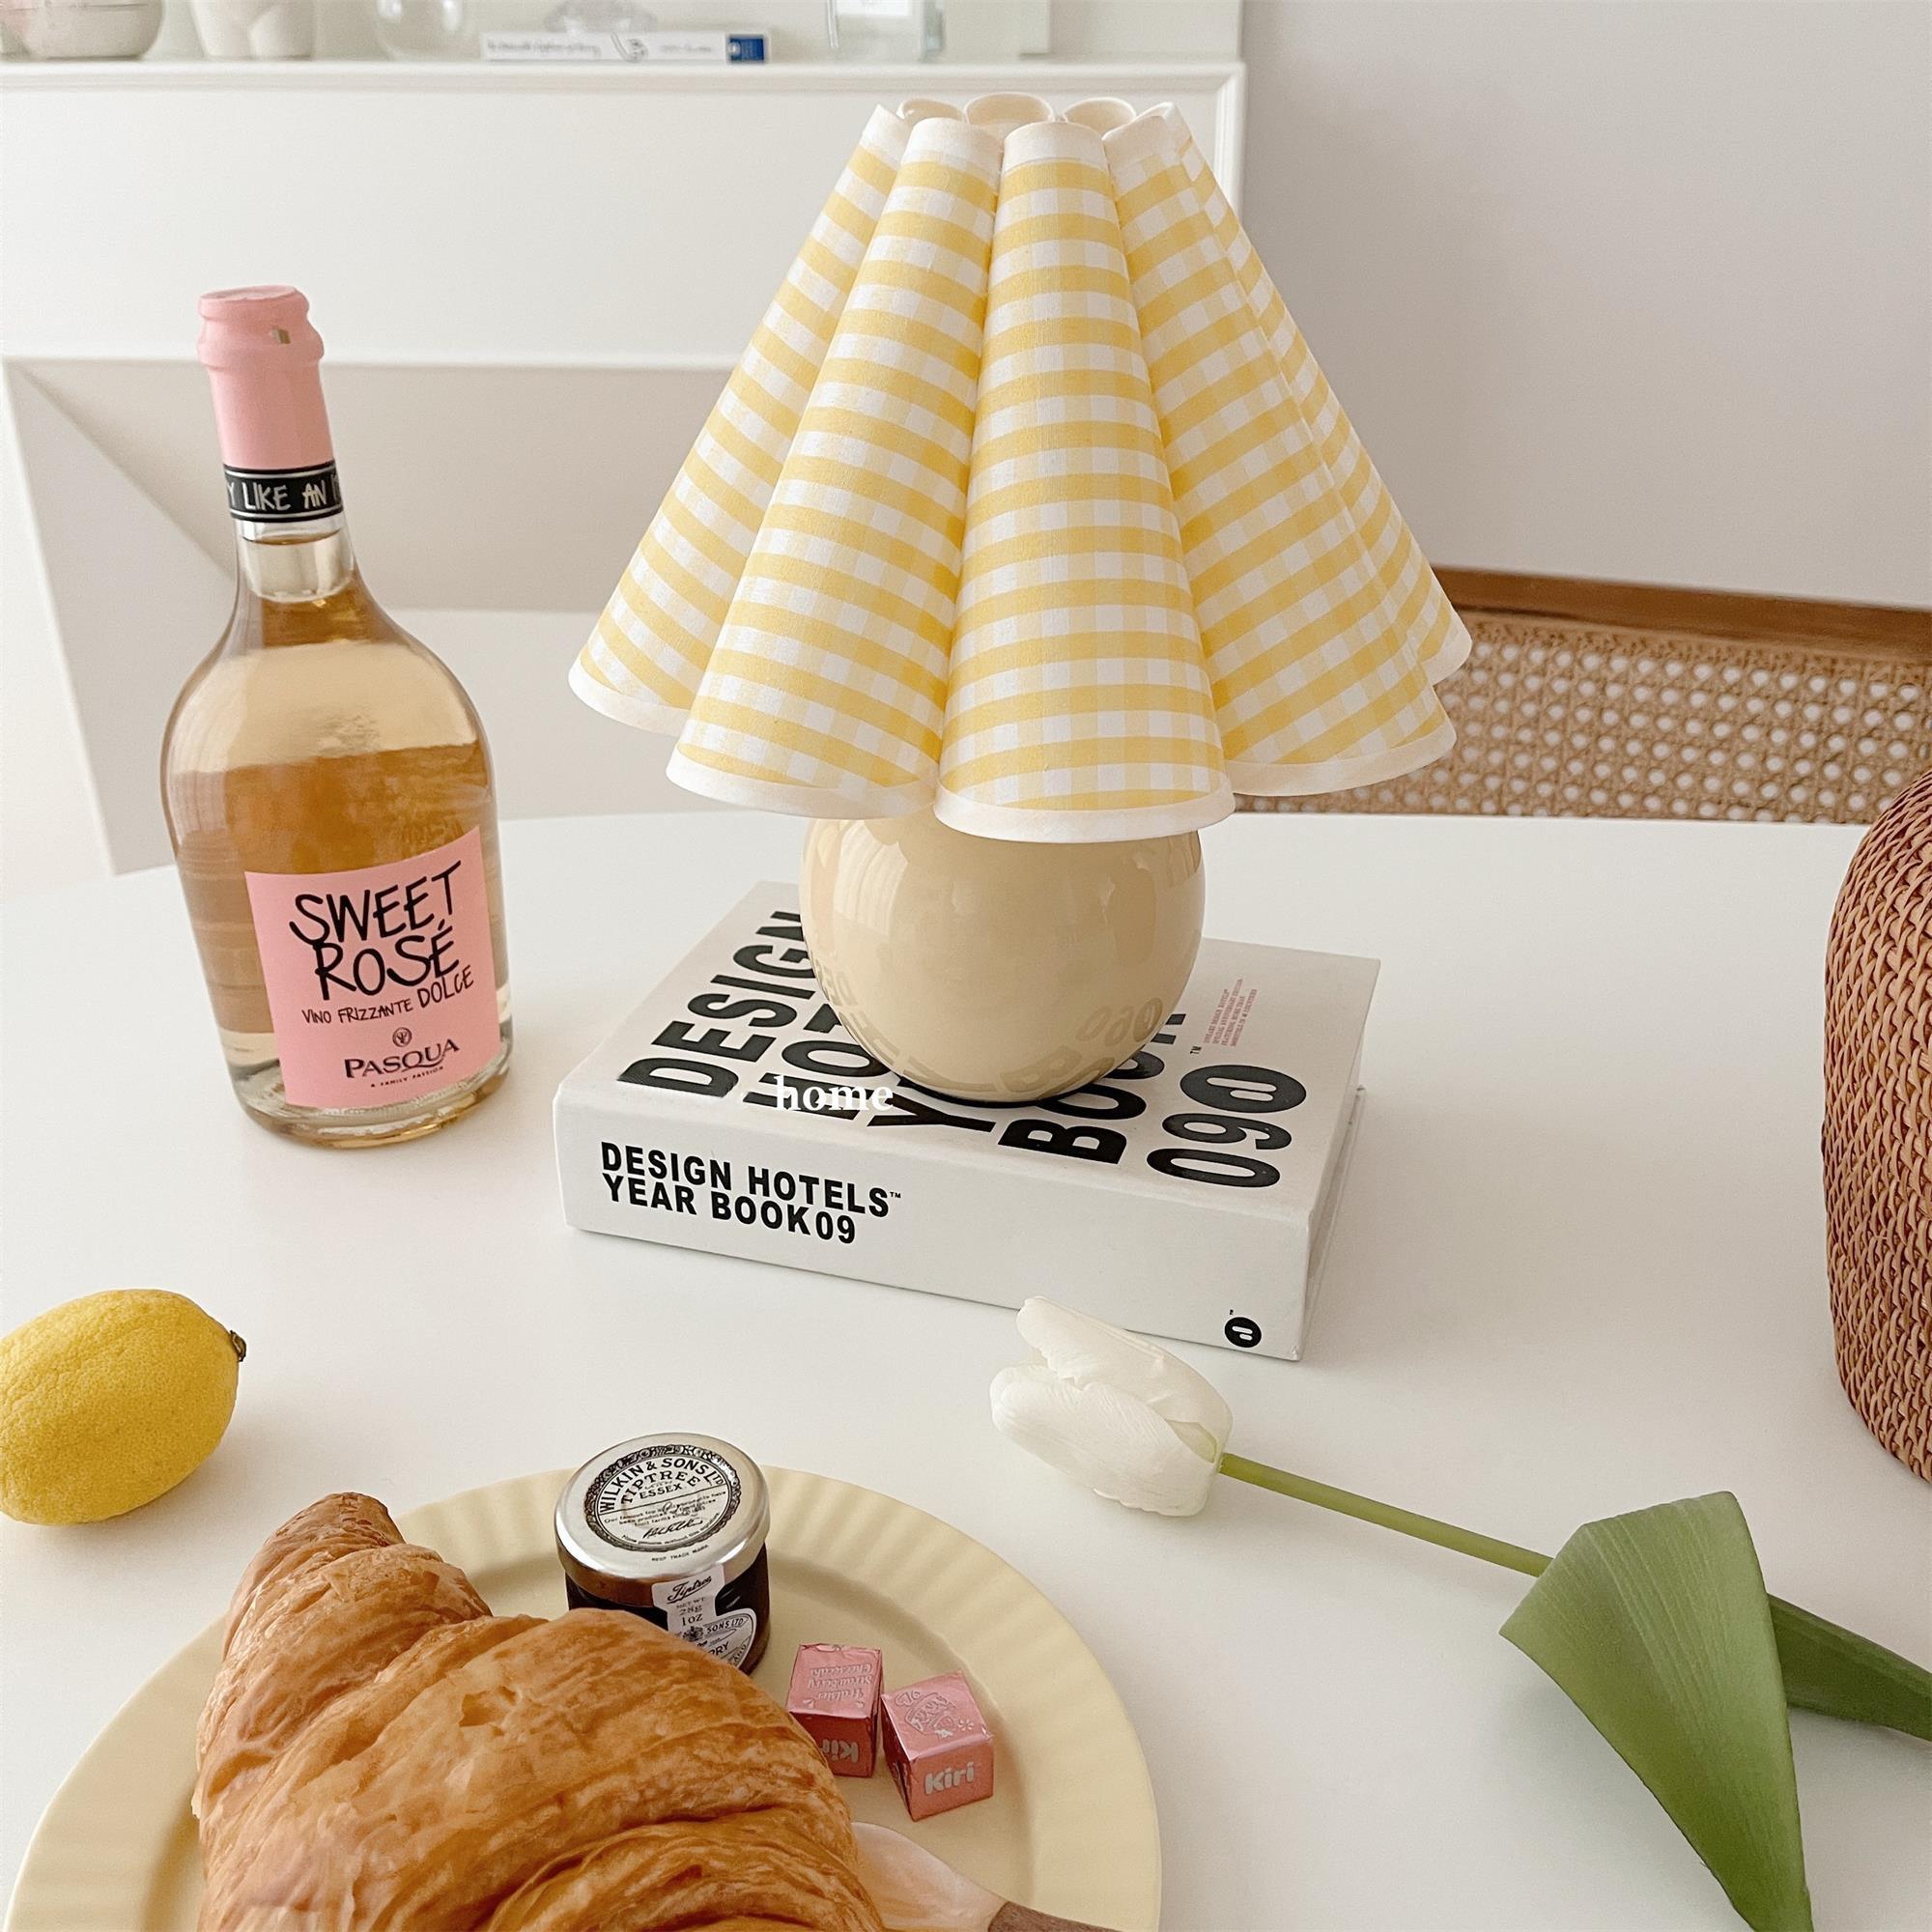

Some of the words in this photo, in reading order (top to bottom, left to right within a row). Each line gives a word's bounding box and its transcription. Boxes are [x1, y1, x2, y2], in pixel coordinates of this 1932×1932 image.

[242, 482, 291, 511] LIKE
[301, 480, 327, 509] AN
[289, 860, 462, 946] SWEET
[312, 919, 460, 1000] ROSÉ
[301, 1009, 331, 1024] VINO
[338, 998, 413, 1024] FRIZZANTE
[416, 964, 474, 1008] DOLCE
[344, 1038, 460, 1078] PASQUA
[601, 1141, 731, 1191] DESIGN
[602, 1173, 696, 1215] YEAR
[599, 1464, 644, 1513] WILKIN
[646, 1461, 658, 1471] &
[661, 1458, 710, 1475] SONS
[620, 1470, 701, 1504] TIPTREE
[639, 1483, 683, 1499] ESSEX
[707, 1620, 730, 1634] SONS
[821, 1739, 860, 1764] Kir
